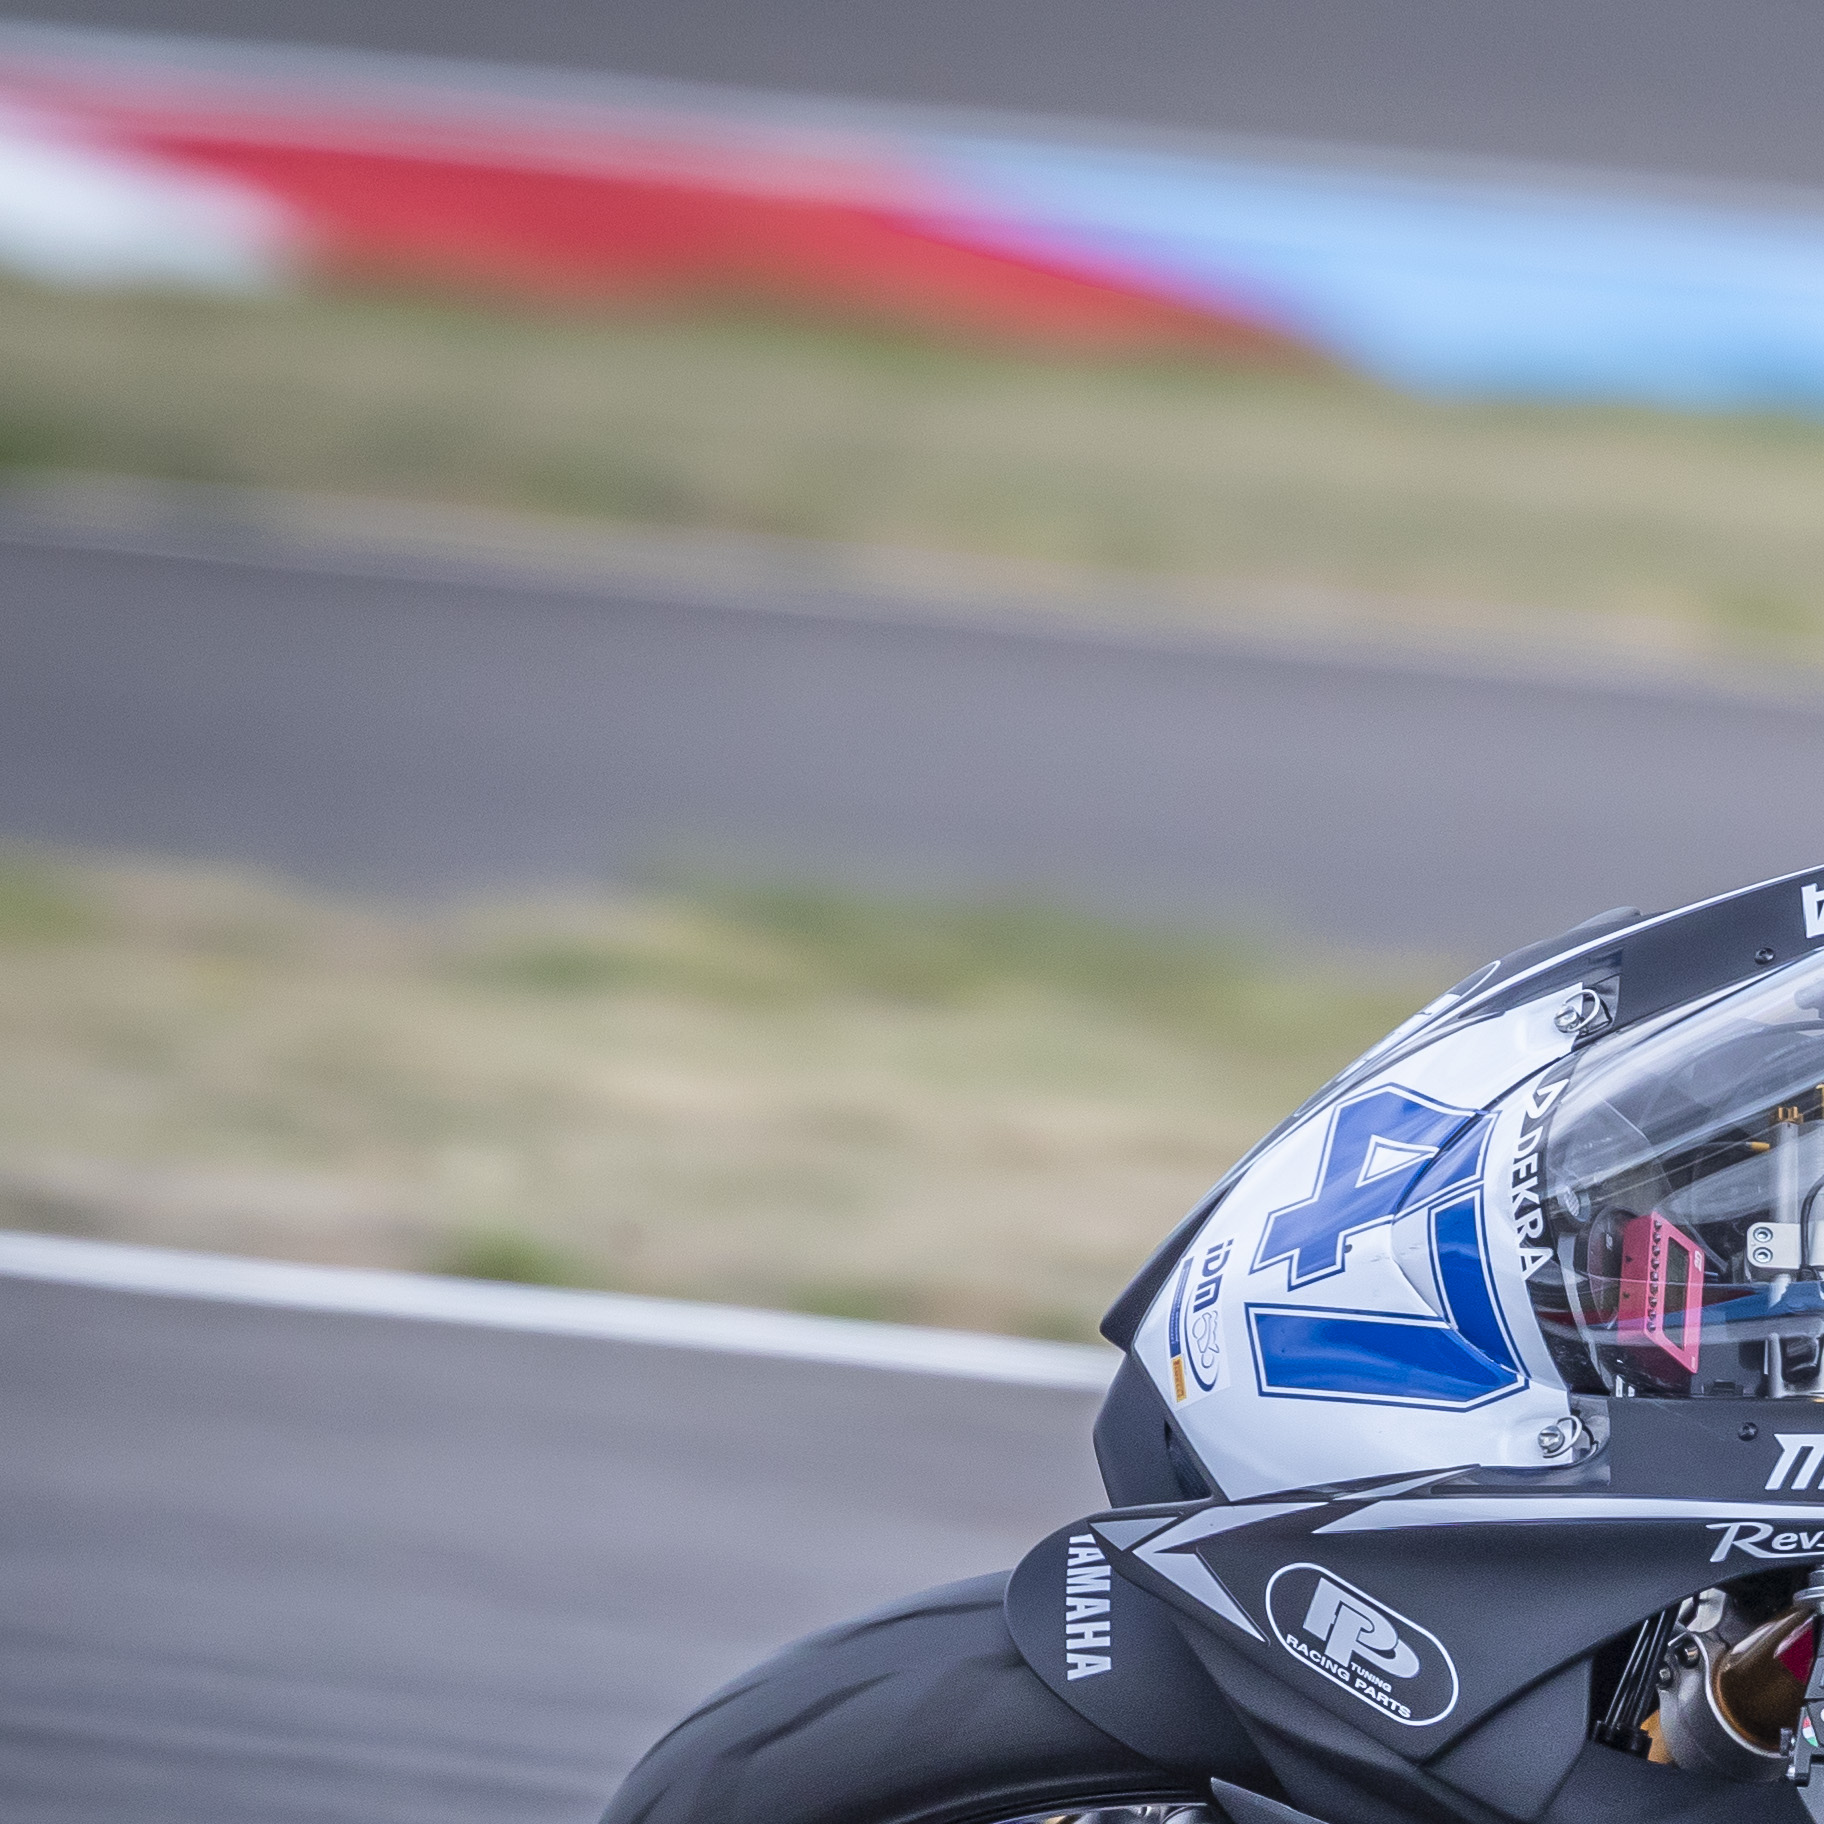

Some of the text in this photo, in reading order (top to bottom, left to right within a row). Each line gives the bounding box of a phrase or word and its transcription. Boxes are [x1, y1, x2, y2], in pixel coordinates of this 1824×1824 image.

[1249, 1083, 1531, 1412] 47
[1506, 1142, 1556, 1283] DEKRA
[1286, 1633, 1412, 1718] RACING PARTS
[1349, 1661, 1393, 1693] TUNING
